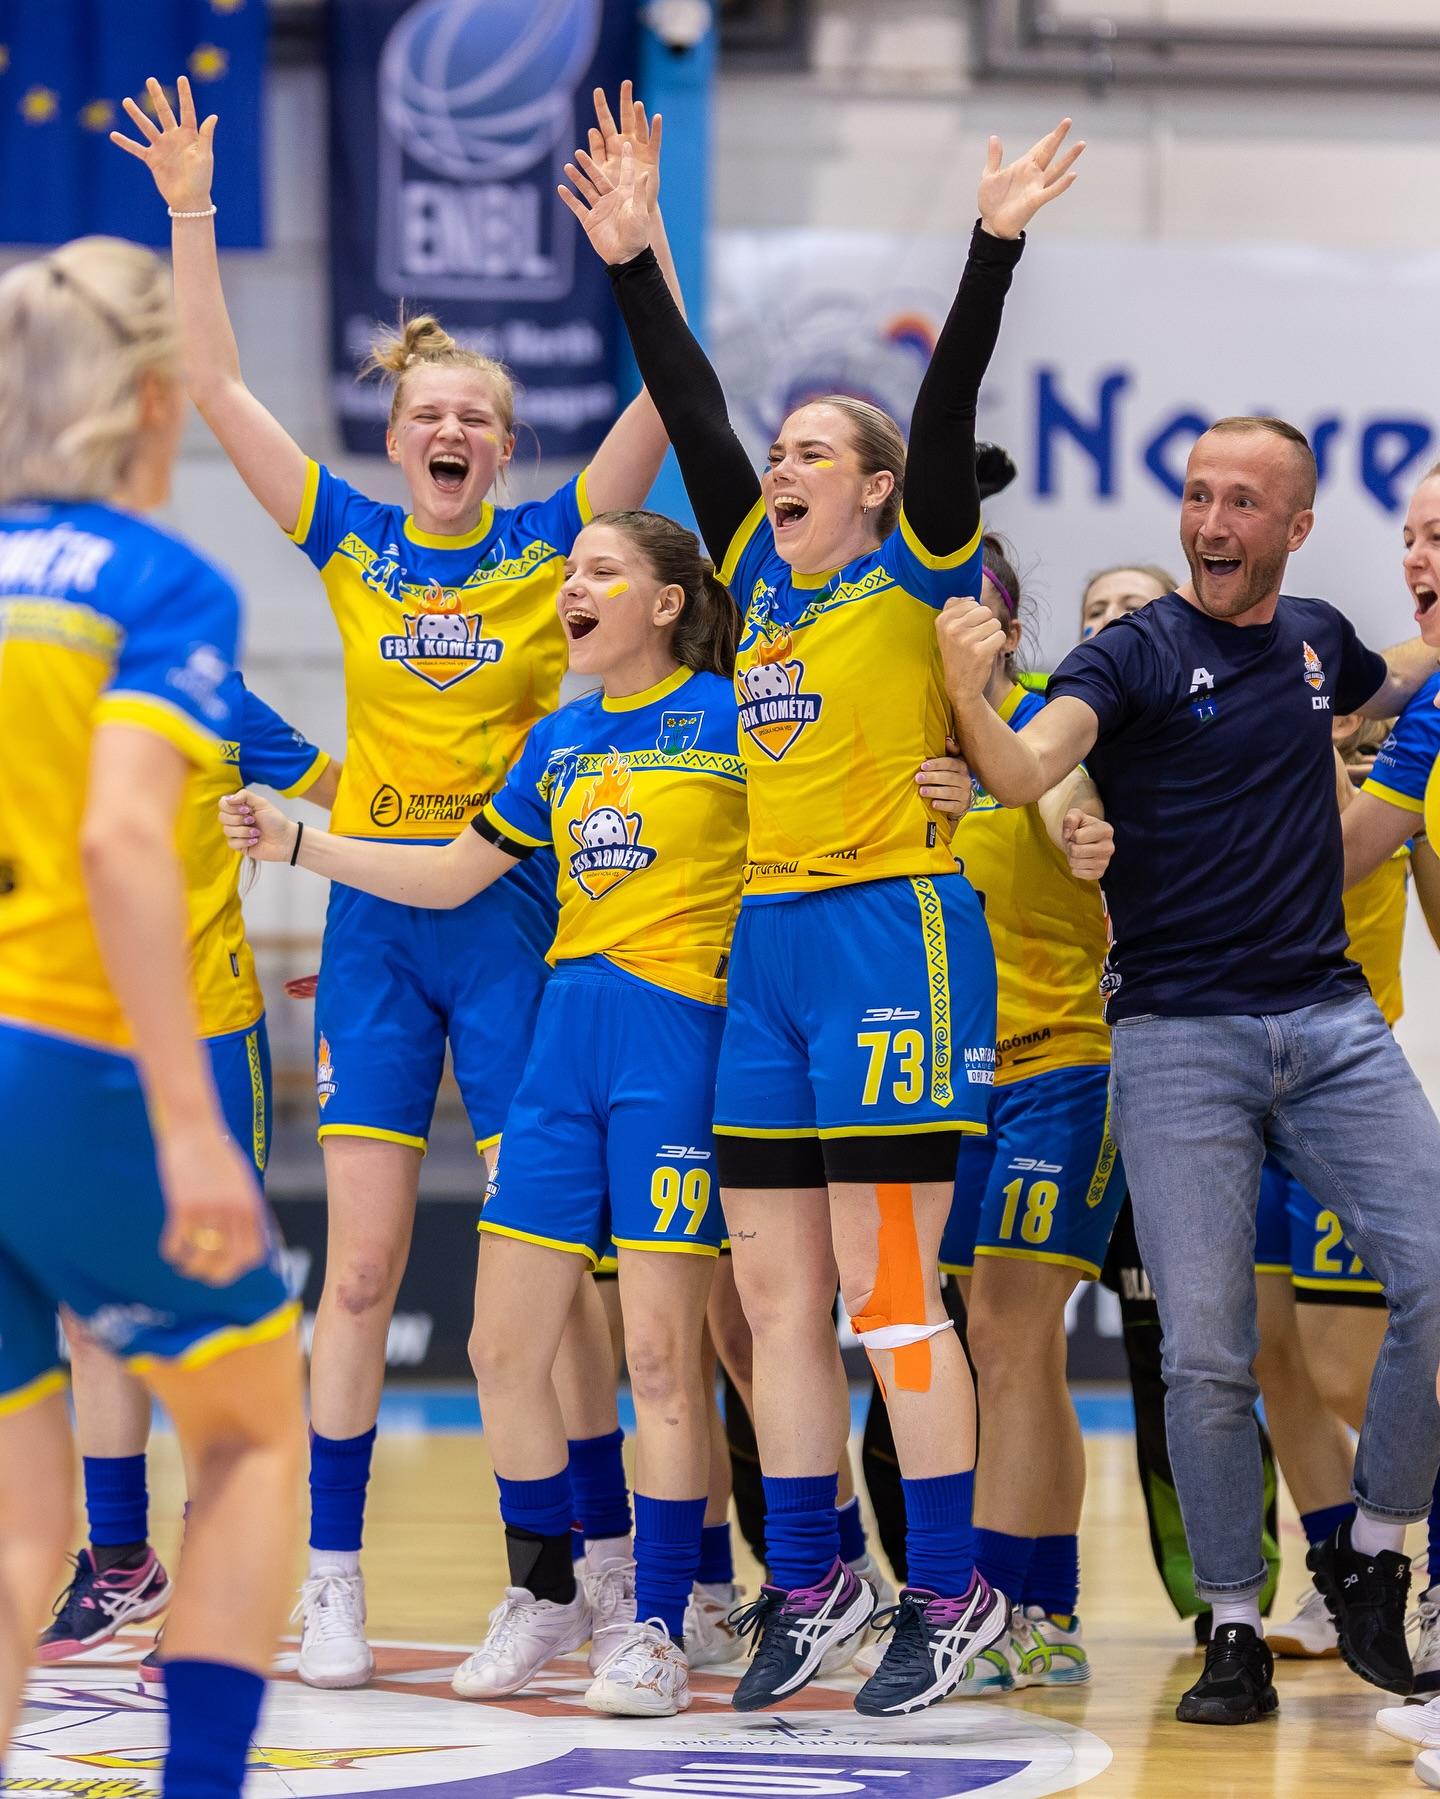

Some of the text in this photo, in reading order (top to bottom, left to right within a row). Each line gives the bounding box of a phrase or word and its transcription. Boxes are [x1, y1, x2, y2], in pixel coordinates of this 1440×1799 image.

[385, 638, 419, 657] FBK
[760, 697, 815, 722] KOMÉTA
[1311, 696, 1330, 710] DK
[405, 806, 465, 820] POPRAD
[592, 847, 649, 869] KOMÉTA
[857, 1028, 925, 1106] 73
[650, 1166, 711, 1235] 99
[999, 1177, 1060, 1245] 18
